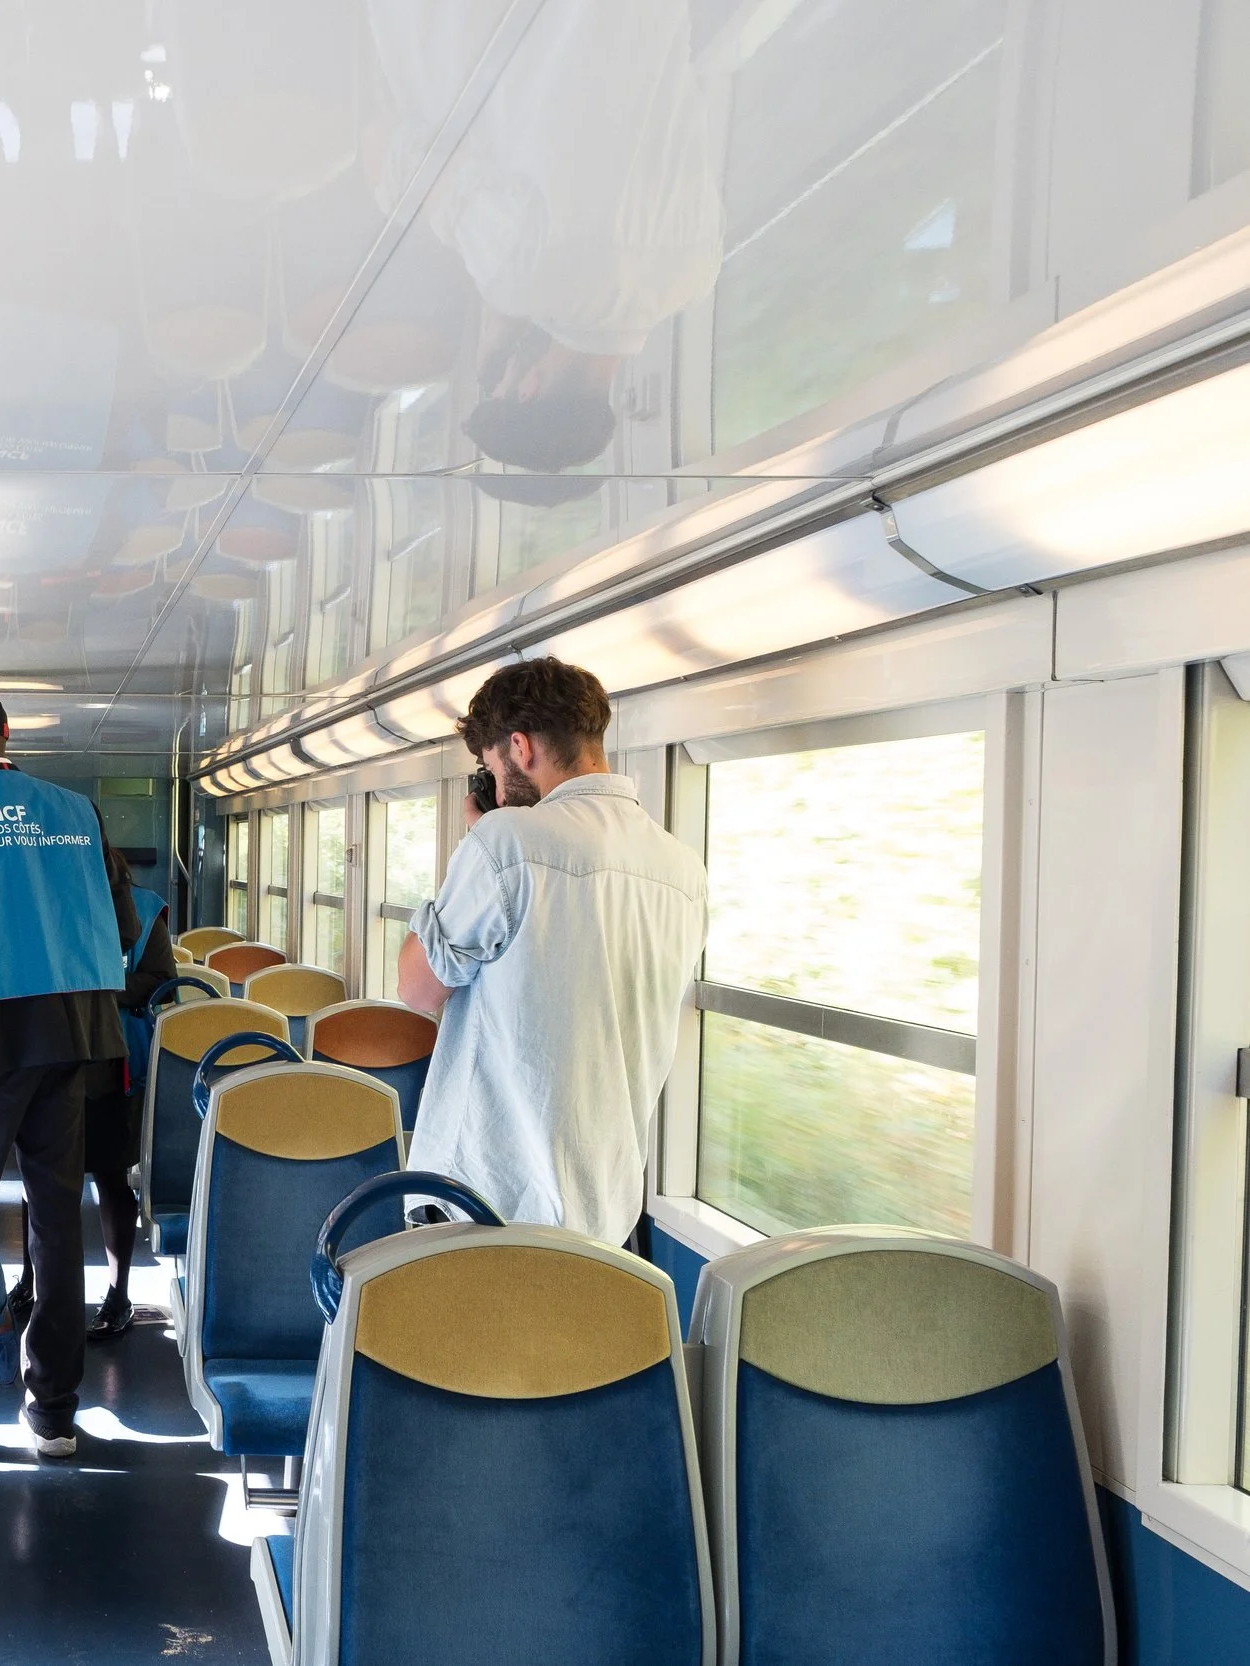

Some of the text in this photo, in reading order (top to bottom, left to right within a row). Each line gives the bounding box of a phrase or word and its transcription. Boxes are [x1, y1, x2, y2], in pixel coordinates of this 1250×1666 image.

[12, 821, 44, 836] CÔTÉS,
[15, 835, 38, 847] VOUS
[39, 835, 92, 847] INFORMER
